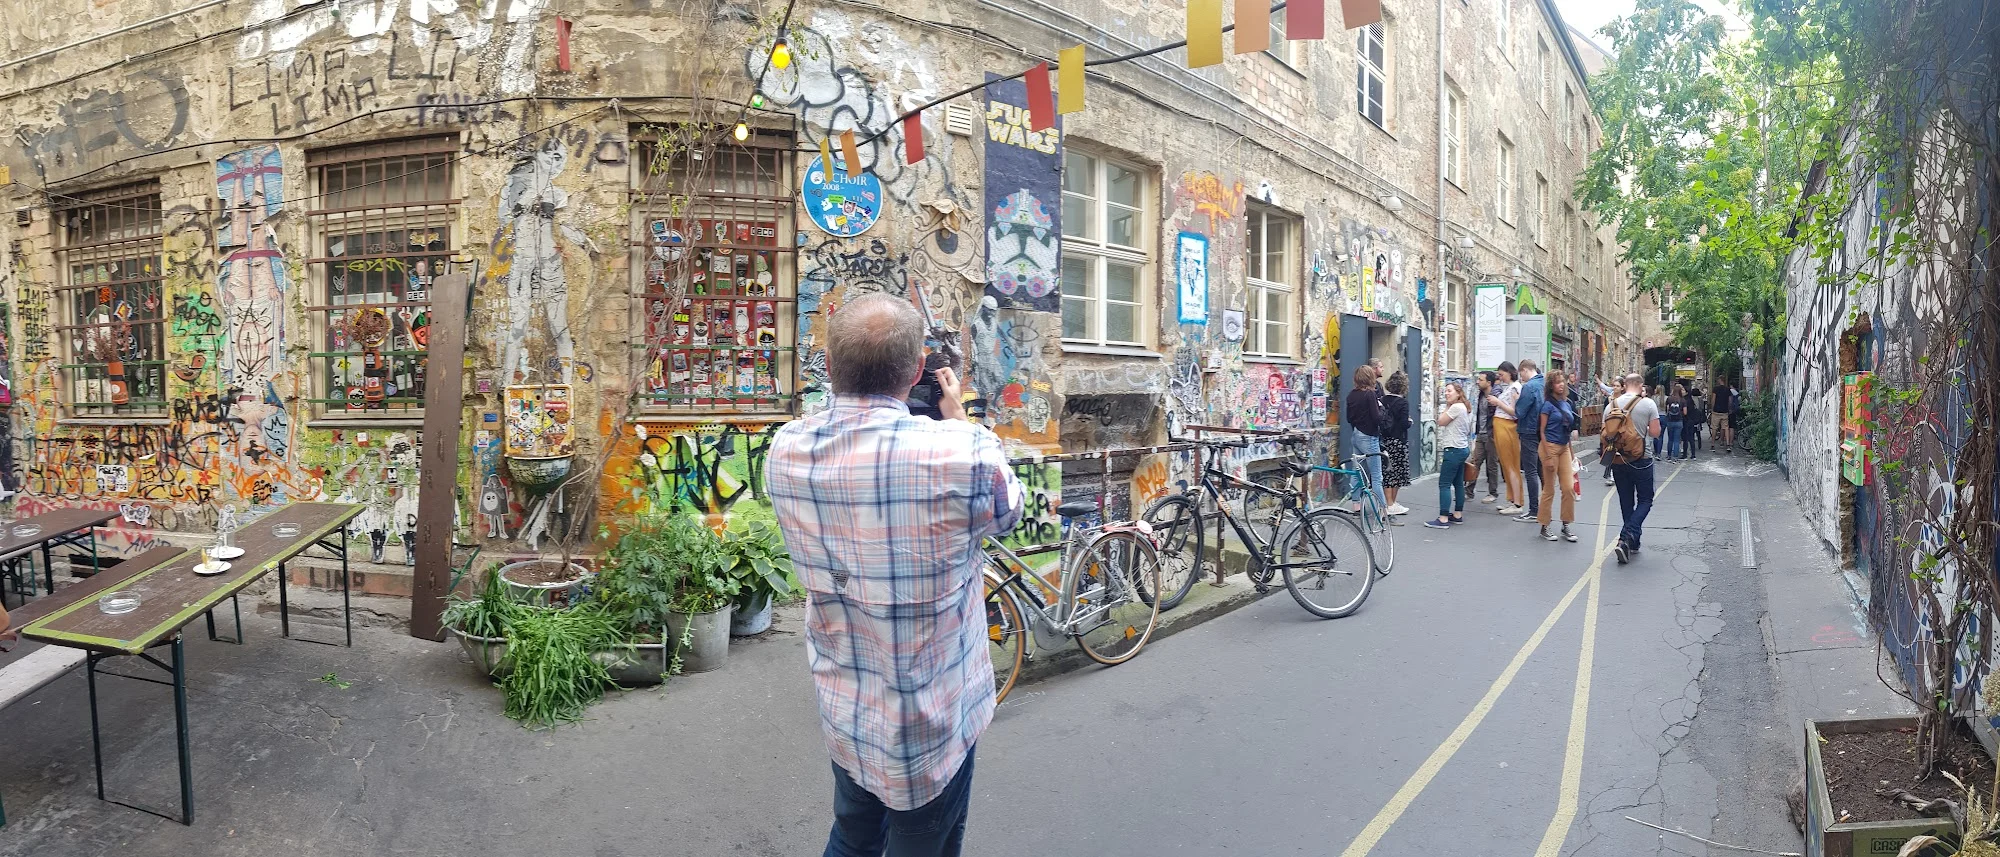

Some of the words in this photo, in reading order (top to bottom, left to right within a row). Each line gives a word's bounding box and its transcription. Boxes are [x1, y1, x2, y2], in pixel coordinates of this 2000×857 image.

[986, 100, 1060, 138] FUC
[986, 119, 1057, 155] WARS
[821, 172, 868, 187] CHOIR
